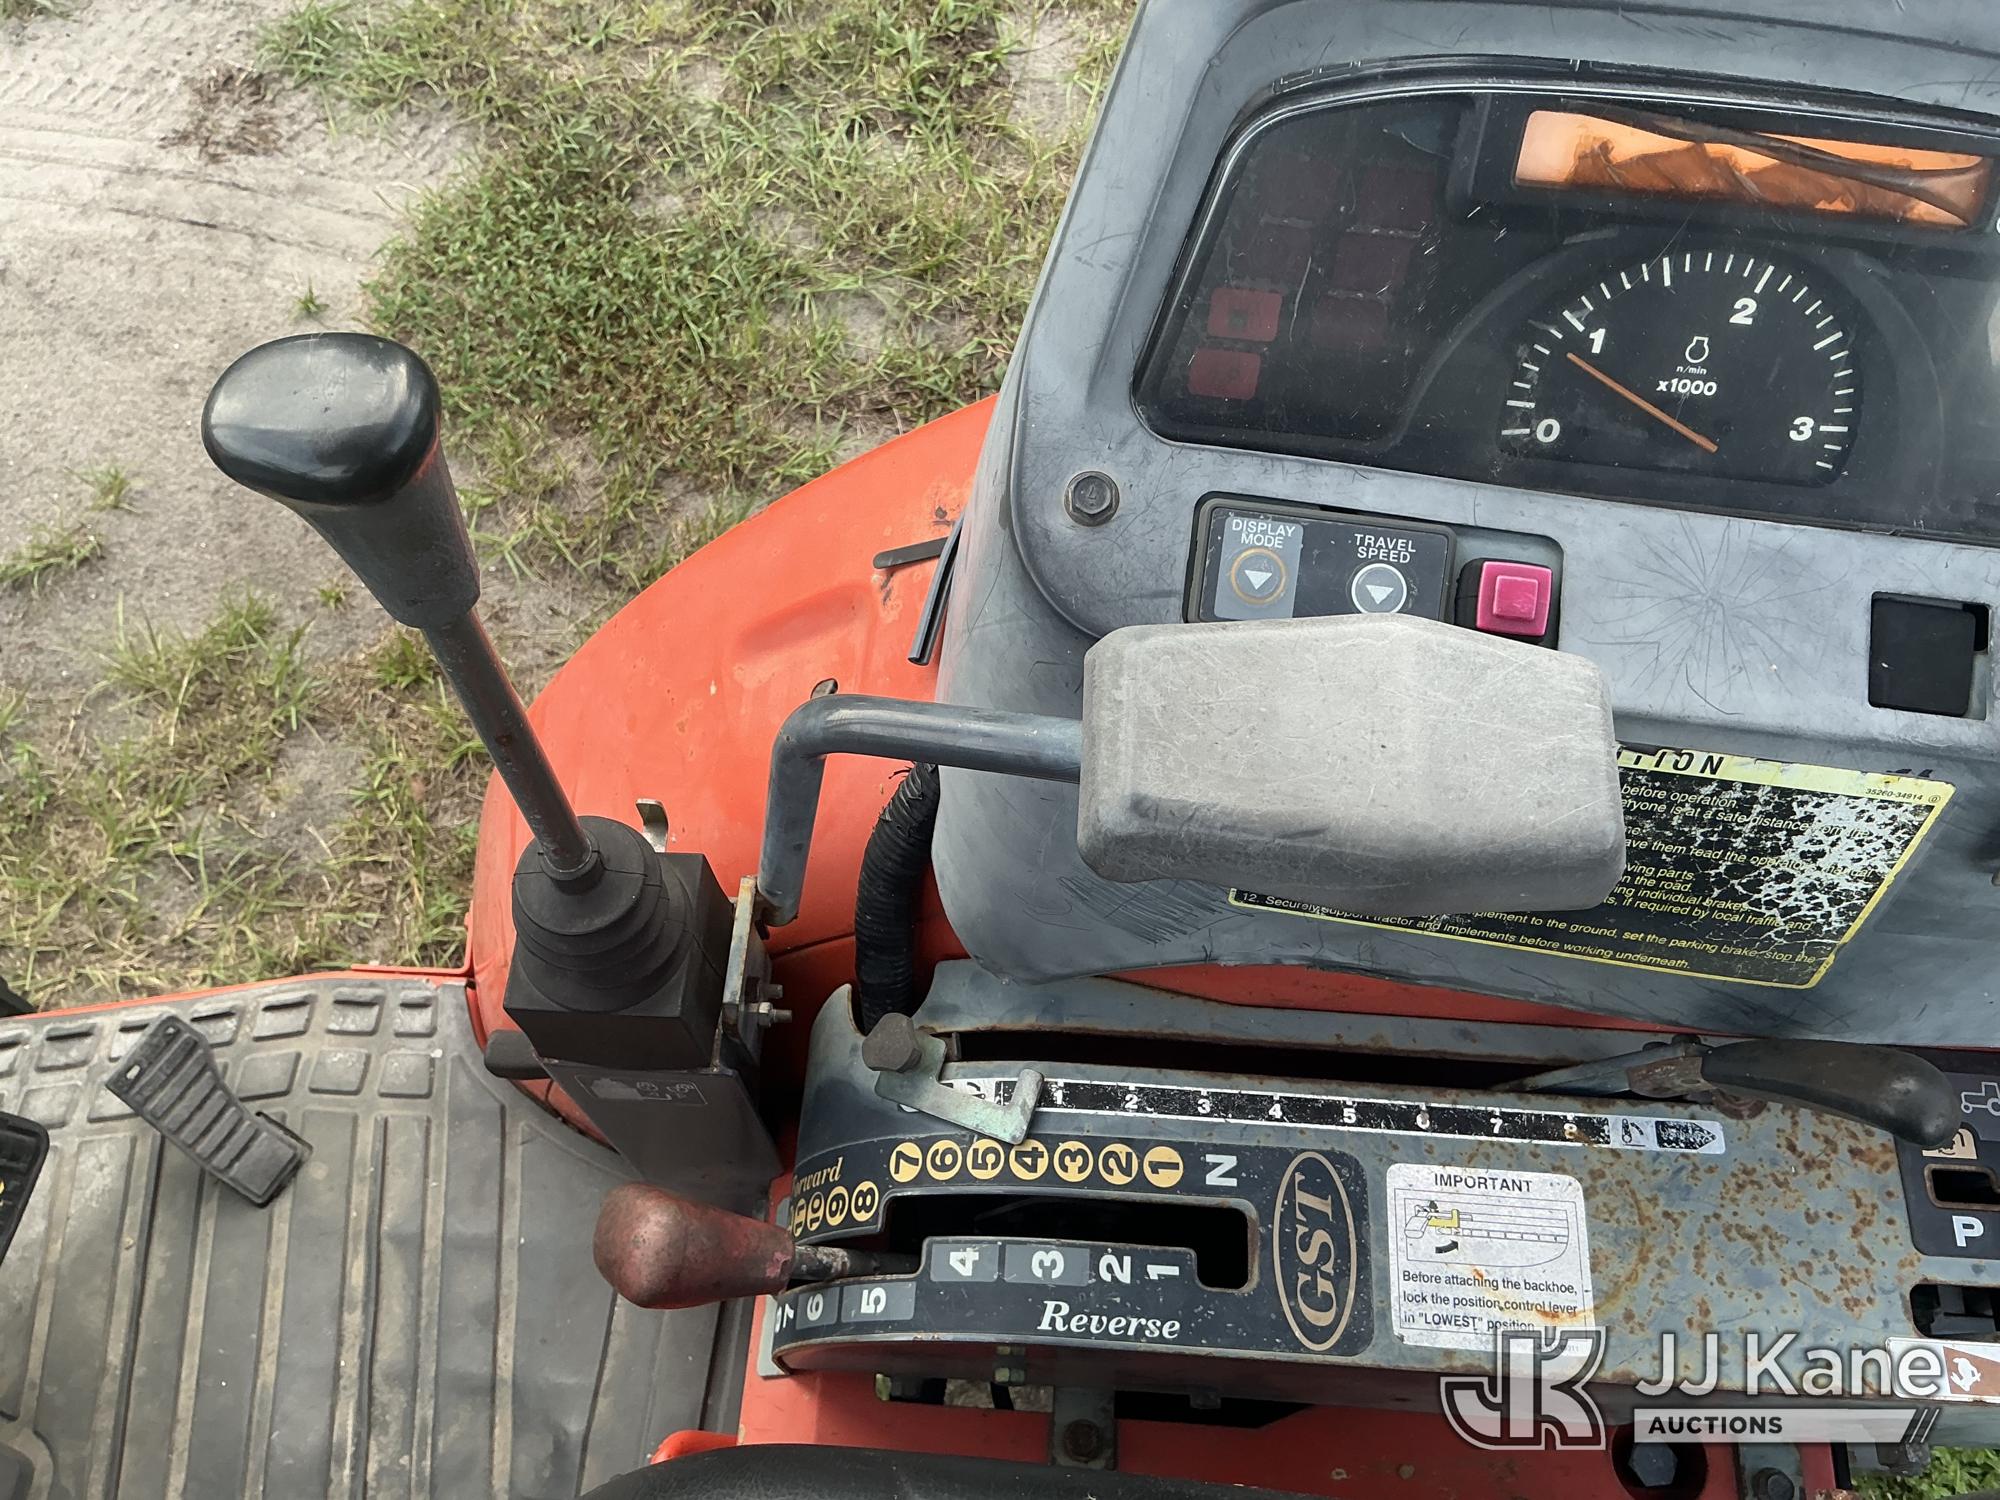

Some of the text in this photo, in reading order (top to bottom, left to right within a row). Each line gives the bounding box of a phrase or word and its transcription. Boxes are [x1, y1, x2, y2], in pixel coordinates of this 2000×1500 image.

[1729, 298, 1758, 325] 2
[1589, 328, 1606, 354] 1
[1676, 365, 1707, 376] n/min
[1656, 379, 1717, 396] x1000
[1536, 418, 1561, 443] 0
[1789, 416, 1815, 441] 3
[1232, 519, 1296, 537] DISPLAY
[1240, 533, 1284, 549] MODE
[1354, 533, 1417, 553] TRAVEL
[1357, 547, 1411, 564] SPEED
[1621, 784, 1739, 809] before operation.
[1670, 803, 1682, 815] is
[1685, 808, 1701, 818] at
[1703, 810, 1713, 819] a
[1716, 812, 1747, 823] safe
[1750, 815, 1810, 831] distance
[1651, 841, 1686, 855] them
[1690, 845, 1724, 858] read
[1726, 851, 1747, 862] the
[1634, 875, 1656, 887] the
[1659, 880, 1693, 892] road.
[1657, 868, 1695, 882] parts.
[1638, 887, 1702, 905] individual
[1621, 897, 1634, 906] if
[1634, 899, 1690, 916] required
[1693, 908, 1709, 919] by
[1712, 910, 1745, 925] local
[1747, 915, 1782, 929] traffic
[1788, 920, 1813, 931] and
[1443, 923, 1517, 943] implements
[1519, 936, 1561, 950] before
[1563, 943, 1613, 959] working
[1616, 951, 1691, 970] underneath.
[1530, 916, 1543, 926] to
[1547, 918, 1567, 930] the
[1569, 924, 1618, 939] ground,
[1622, 930, 1644, 941] set
[1646, 933, 1667, 945] the
[1668, 938, 1718, 954] parking
[1764, 951, 1792, 964] stop
[1795, 951, 1817, 964] the
[1053, 1089, 1065, 1105] 1
[1125, 1094, 1138, 1109] 2
[1197, 1099, 1211, 1114] 3
[1268, 1103, 1283, 1119] 4
[1343, 1108, 1357, 1124] 5
[1489, 1117, 1503, 1134] 7
[1564, 1122, 1578, 1139] 8
[894, 1150, 920, 1175] 7
[930, 1149, 958, 1173] 6
[972, 1146, 1001, 1170] 5
[1014, 1147, 1045, 1174] 4
[1058, 1150, 1090, 1175] 3
[1102, 1151, 1133, 1177] 2
[1434, 1173, 1533, 1193] IMPORTANT
[828, 1193, 847, 1218] 9
[854, 1188, 877, 1214] 8
[1952, 1215, 1984, 1247] P
[1294, 1172, 1336, 1327] GST
[949, 1247, 1180, 1284] 4 3 2 1
[1403, 1270, 1578, 1296] Before attaching the backhoe,
[806, 1293, 824, 1321] 6
[860, 1287, 887, 1314] 5
[1403, 1291, 1578, 1314] lock the position control lever
[1037, 1299, 1180, 1339] Reverse
[1404, 1312, 1415, 1324] in
[1419, 1312, 1483, 1329] "LOWEST"
